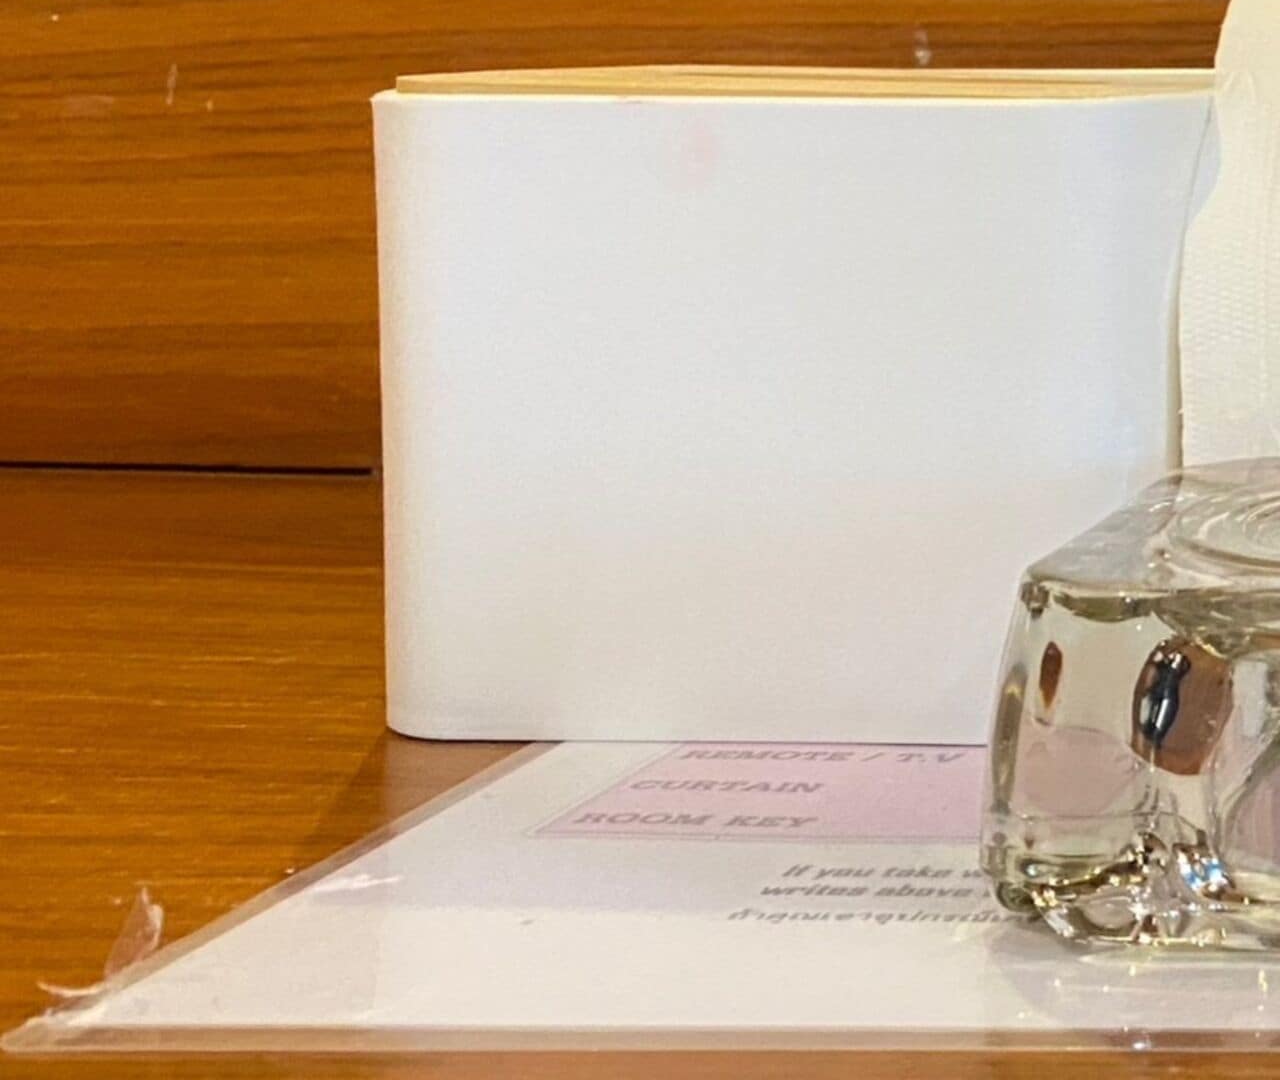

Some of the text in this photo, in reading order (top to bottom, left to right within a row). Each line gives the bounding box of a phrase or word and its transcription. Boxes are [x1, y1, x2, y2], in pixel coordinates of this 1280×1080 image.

[681, 749, 856, 762] REMOTE
[628, 779, 824, 795] CURTAIN
[573, 812, 820, 828] ROOM KEY
[781, 864, 815, 878] If
[813, 867, 876, 881] you
[880, 866, 949, 879] take
[873, 884, 974, 897] above
